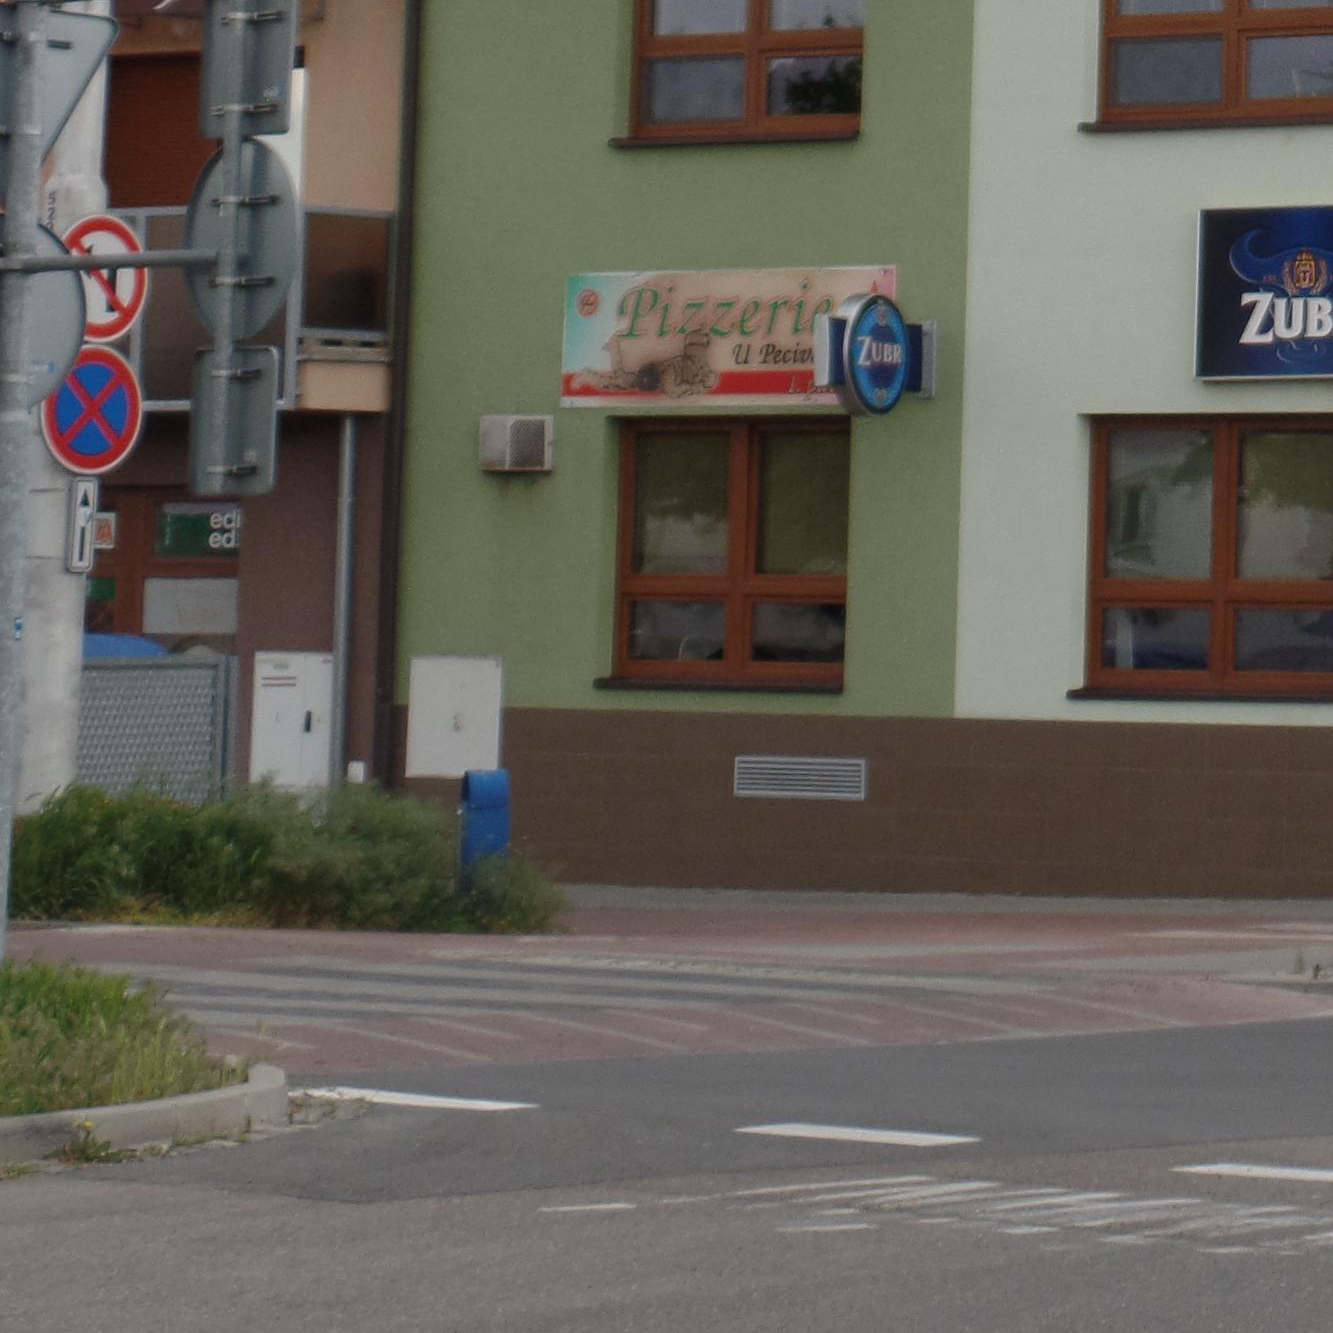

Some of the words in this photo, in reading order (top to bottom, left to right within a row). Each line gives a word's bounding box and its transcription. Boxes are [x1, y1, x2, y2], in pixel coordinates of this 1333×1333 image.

[732, 343, 750, 365] U
[759, 343, 815, 365] Peciv
[857, 335, 903, 366] ZUBR
